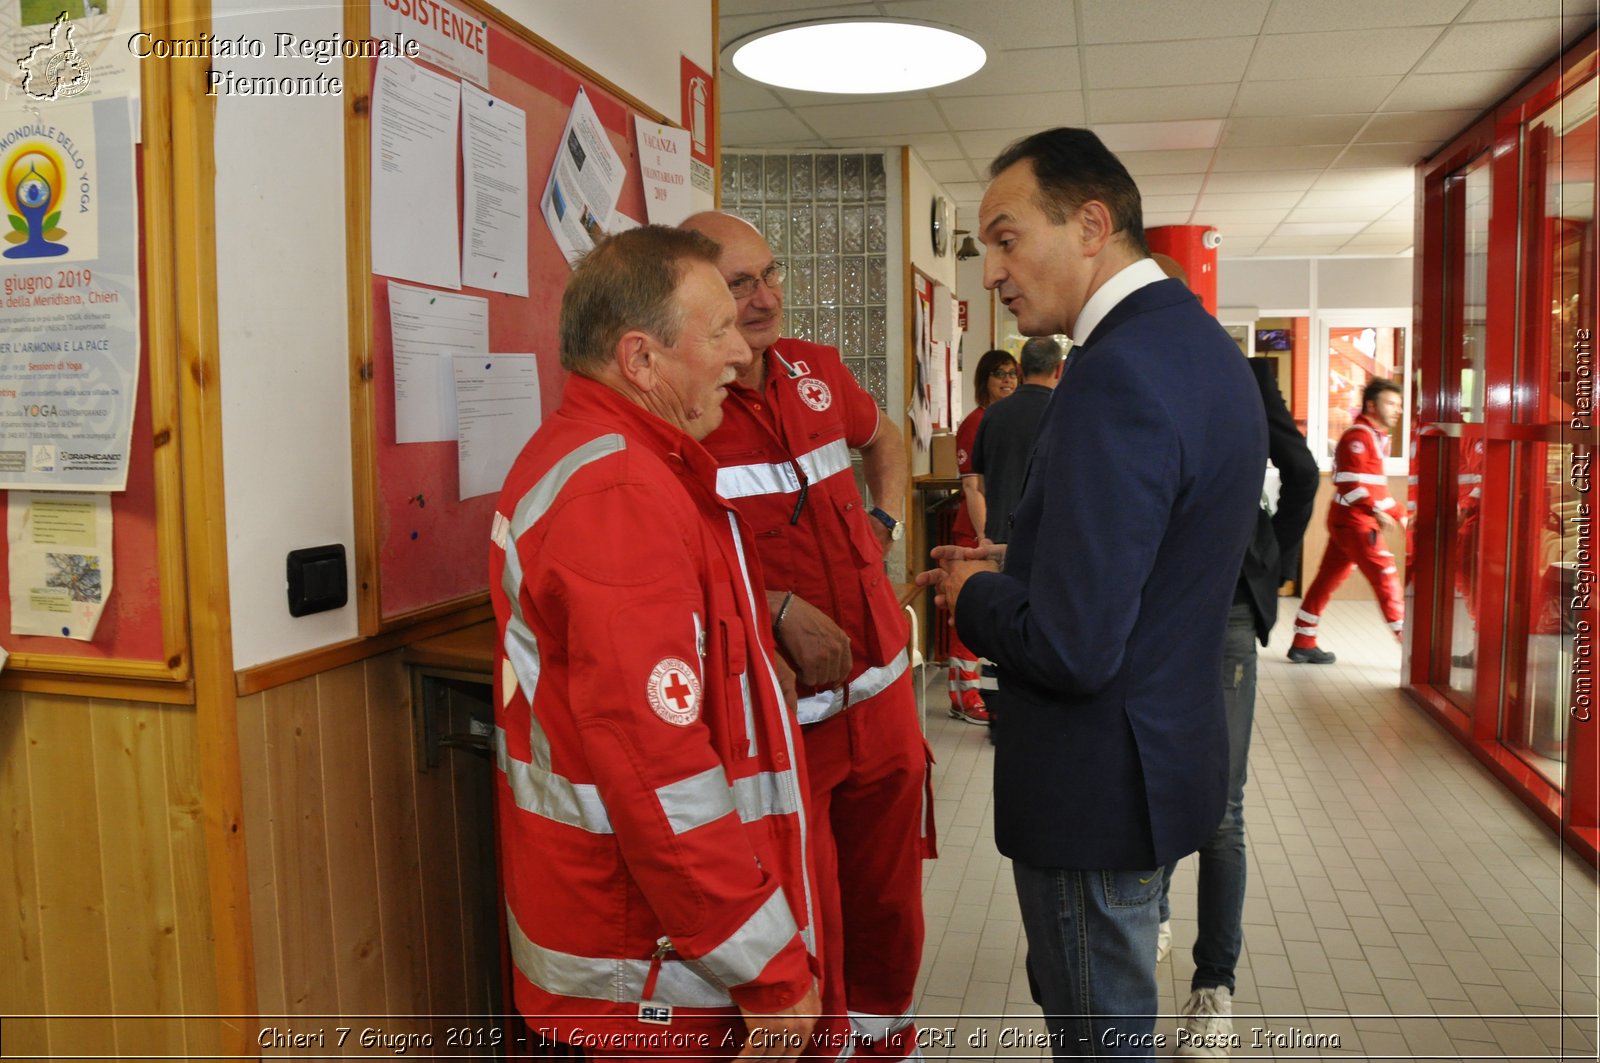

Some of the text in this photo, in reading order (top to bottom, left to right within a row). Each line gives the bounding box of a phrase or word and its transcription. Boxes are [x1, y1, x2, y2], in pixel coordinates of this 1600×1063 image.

[383, 0, 484, 55] SISTENZE
[643, 132, 677, 154] VACANZA
[0, 124, 91, 214] MONDIALE DELLO YOGA
[4, 269, 92, 296] giugno 2019
[6, 295, 31, 308] della
[88, 290, 119, 304] Chieri
[64, 341, 70, 352] E
[72, 341, 84, 352] LA
[86, 339, 109, 351] PACE
[23, 404, 58, 417] YOGA
